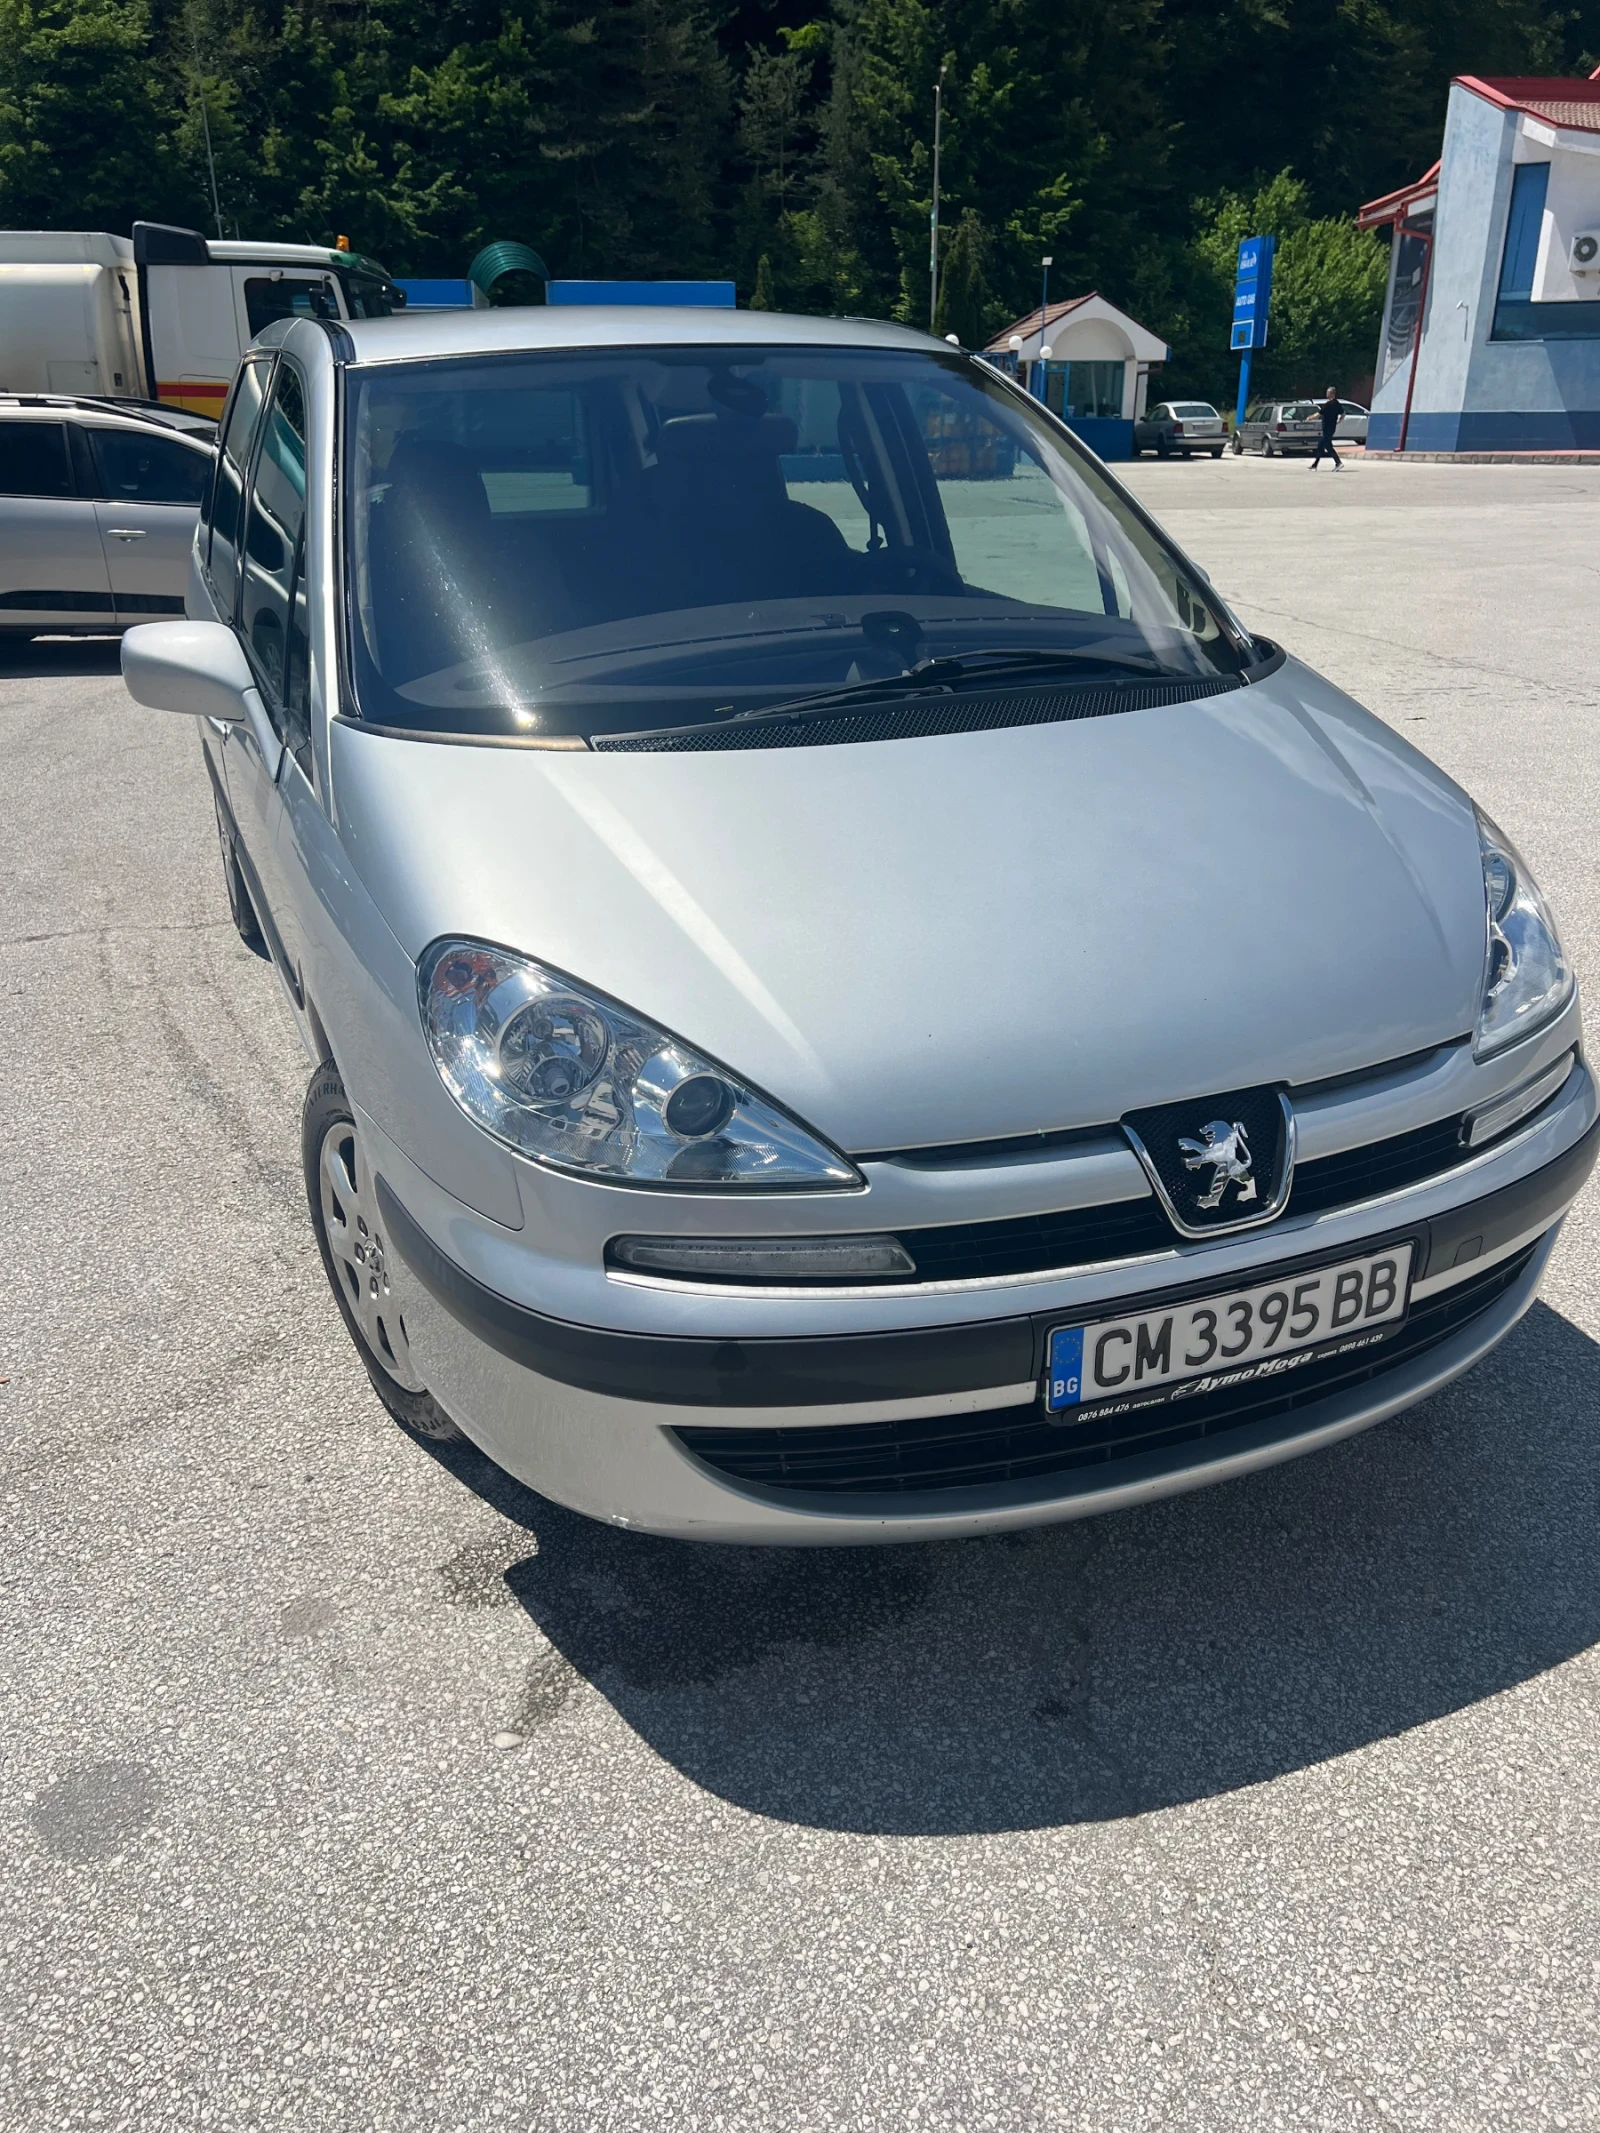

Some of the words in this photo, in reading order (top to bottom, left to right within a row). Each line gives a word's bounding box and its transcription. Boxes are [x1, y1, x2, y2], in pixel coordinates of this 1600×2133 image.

[1093, 1316, 1173, 1388] CM
[1185, 1280, 1321, 1366] 3395
[1331, 1259, 1397, 1329] BB
[1053, 1376, 1079, 1399] BG
[1077, 1410, 1098, 1422] 0876
[1098, 1406, 1113, 1417] 884
[1114, 1402, 1130, 1414] 476
